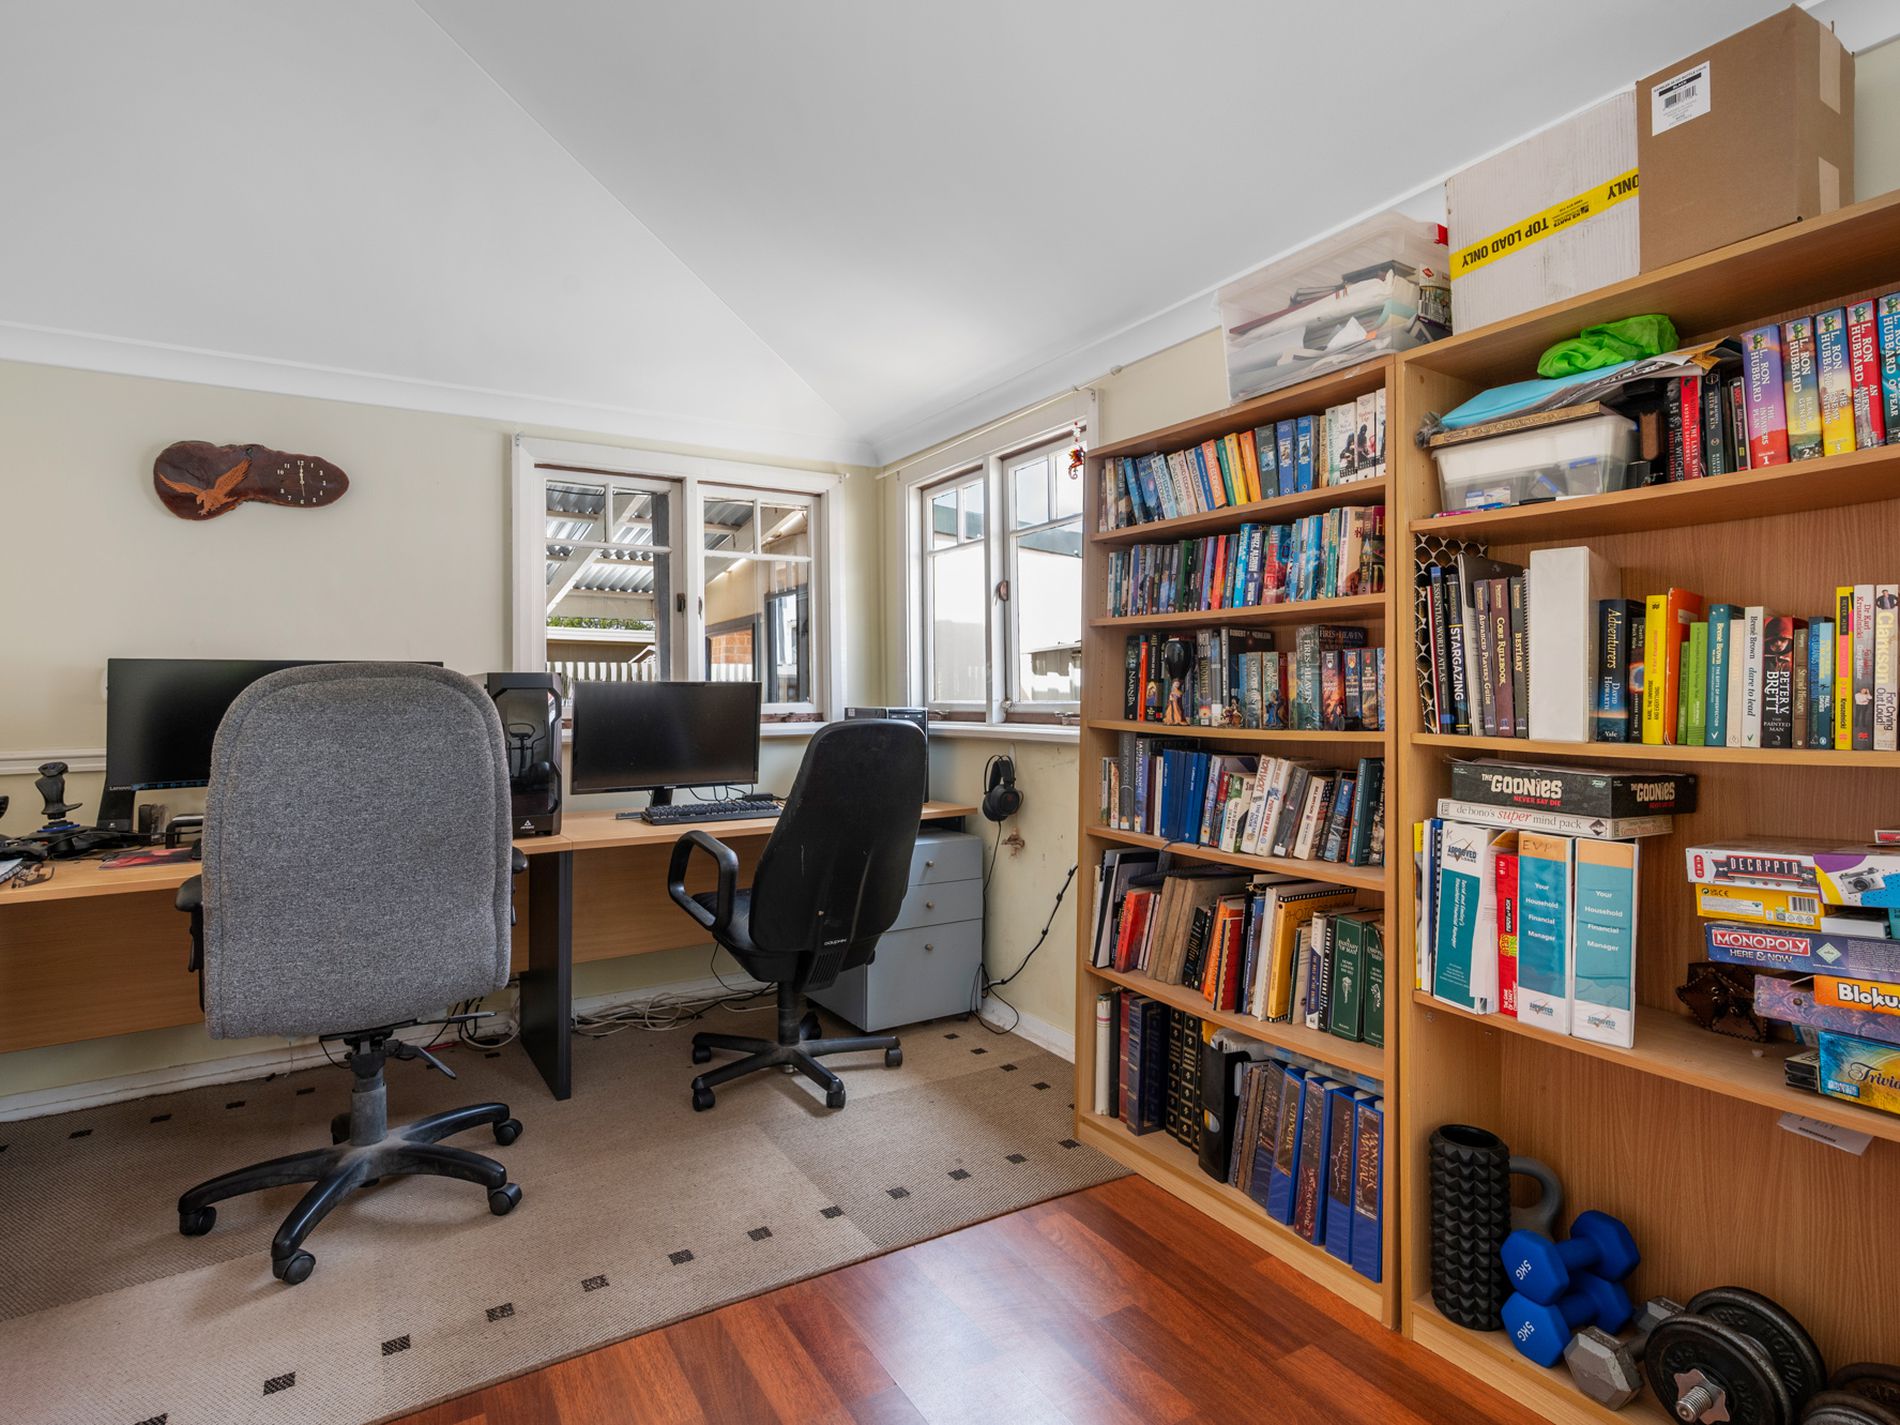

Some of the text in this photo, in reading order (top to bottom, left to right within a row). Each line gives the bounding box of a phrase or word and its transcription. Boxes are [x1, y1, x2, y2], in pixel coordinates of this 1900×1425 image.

[1462, 217, 1549, 268] TOP LOAD ONLY
[1800, 338, 1811, 376] L. RON
[1831, 330, 1842, 369] L. RON
[1851, 325, 1863, 382] HUBBARD
[1862, 323, 1873, 362] L. RON
[1760, 348, 1770, 385] L. RON
[1789, 341, 1802, 393] HUBBARD
[1821, 333, 1833, 387] HUBBARD
[1884, 317, 1898, 416] HUBBARD OF FEAR
[1751, 351, 1762, 402] HUBBARD
[1870, 384, 1877, 396] AN
[1824, 393, 1832, 424] WITHIN
[1832, 391, 1841, 420] ENEMY
[1840, 390, 1848, 407] THE
[1853, 388, 1861, 416] AFFAIR
[1862, 386, 1870, 411] ALIEN
[1690, 424, 1698, 438] THE
[1752, 408, 1760, 429] PLAN
[1760, 406, 1769, 445] INVADERS
[1674, 428, 1683, 443] THE
[1433, 583, 1444, 624] ESSENTIAL
[1864, 604, 1871, 612] Dr
[1436, 626, 1445, 655] WORLD
[1514, 633, 1523, 673] BESTIARY
[1607, 608, 1622, 669] Adventurers
[1876, 612, 1894, 684] Clarkson
[1450, 627, 1464, 701] STARGAZING
[1747, 616, 1758, 716] Brené Brown dare to lead
[1128, 671, 1137, 707] NARNIA
[1604, 676, 1613, 710] HOWARTH
[1612, 682, 1620, 705] DAVID
[1765, 671, 1779, 714] BRETT
[1780, 671, 1790, 703] PETER
[1876, 688, 1885, 726] Out Loud!
[1883, 692, 1896, 731] For Crying
[1481, 773, 1563, 800] THE GOONIES
[1513, 795, 1535, 803] NEVER
[1636, 781, 1676, 803] GOONIES
[1497, 809, 1532, 824] super
[1533, 815, 1557, 827] mind
[1559, 817, 1582, 830] pack
[1729, 856, 1799, 875] DECRYPTO
[1534, 883, 1550, 891] Your
[1595, 890, 1613, 899] Your
[1525, 897, 1559, 910] Household
[1584, 906, 1623, 918] Household
[1528, 914, 1555, 925] Financial
[1587, 923, 1619, 934] Financial
[1527, 931, 1556, 942] Manager
[1586, 940, 1619, 952] Manager
[1715, 932, 1806, 953] MONOPOLY
[1729, 949, 1793, 963] HERE & NOW
[1838, 982, 1900, 1008] Bloku
[1359, 1131, 1370, 1185] MANUAL
[1367, 1130, 1379, 1189] MONSTER
[1515, 1259, 1532, 1281] 5KG
[1517, 1321, 1535, 1342] 5KG
